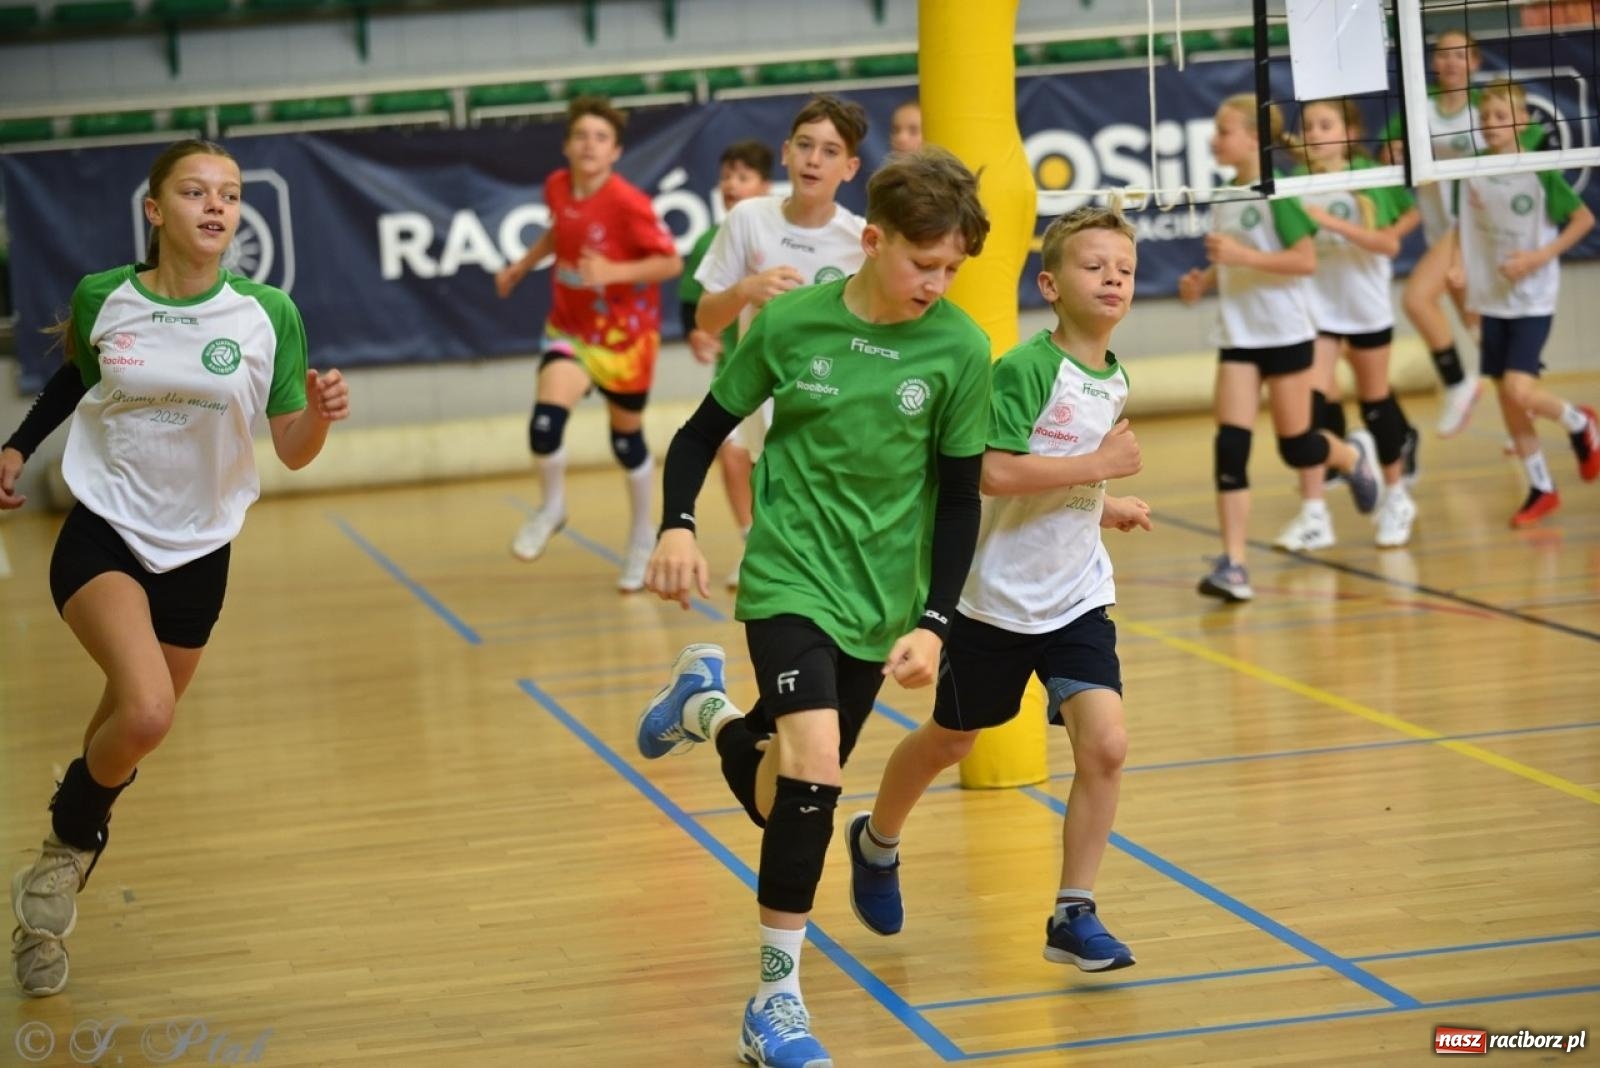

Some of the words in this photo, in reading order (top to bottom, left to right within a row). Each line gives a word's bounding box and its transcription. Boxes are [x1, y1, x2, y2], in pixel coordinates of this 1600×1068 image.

[103, 355, 144, 367] Racibórz
[797, 380, 840, 396] Racibórz
[160, 392, 182, 404] dla
[150, 409, 189, 426] 2025
[1035, 426, 1079, 443] Racibórz
[1065, 496, 1097, 512] 2025
